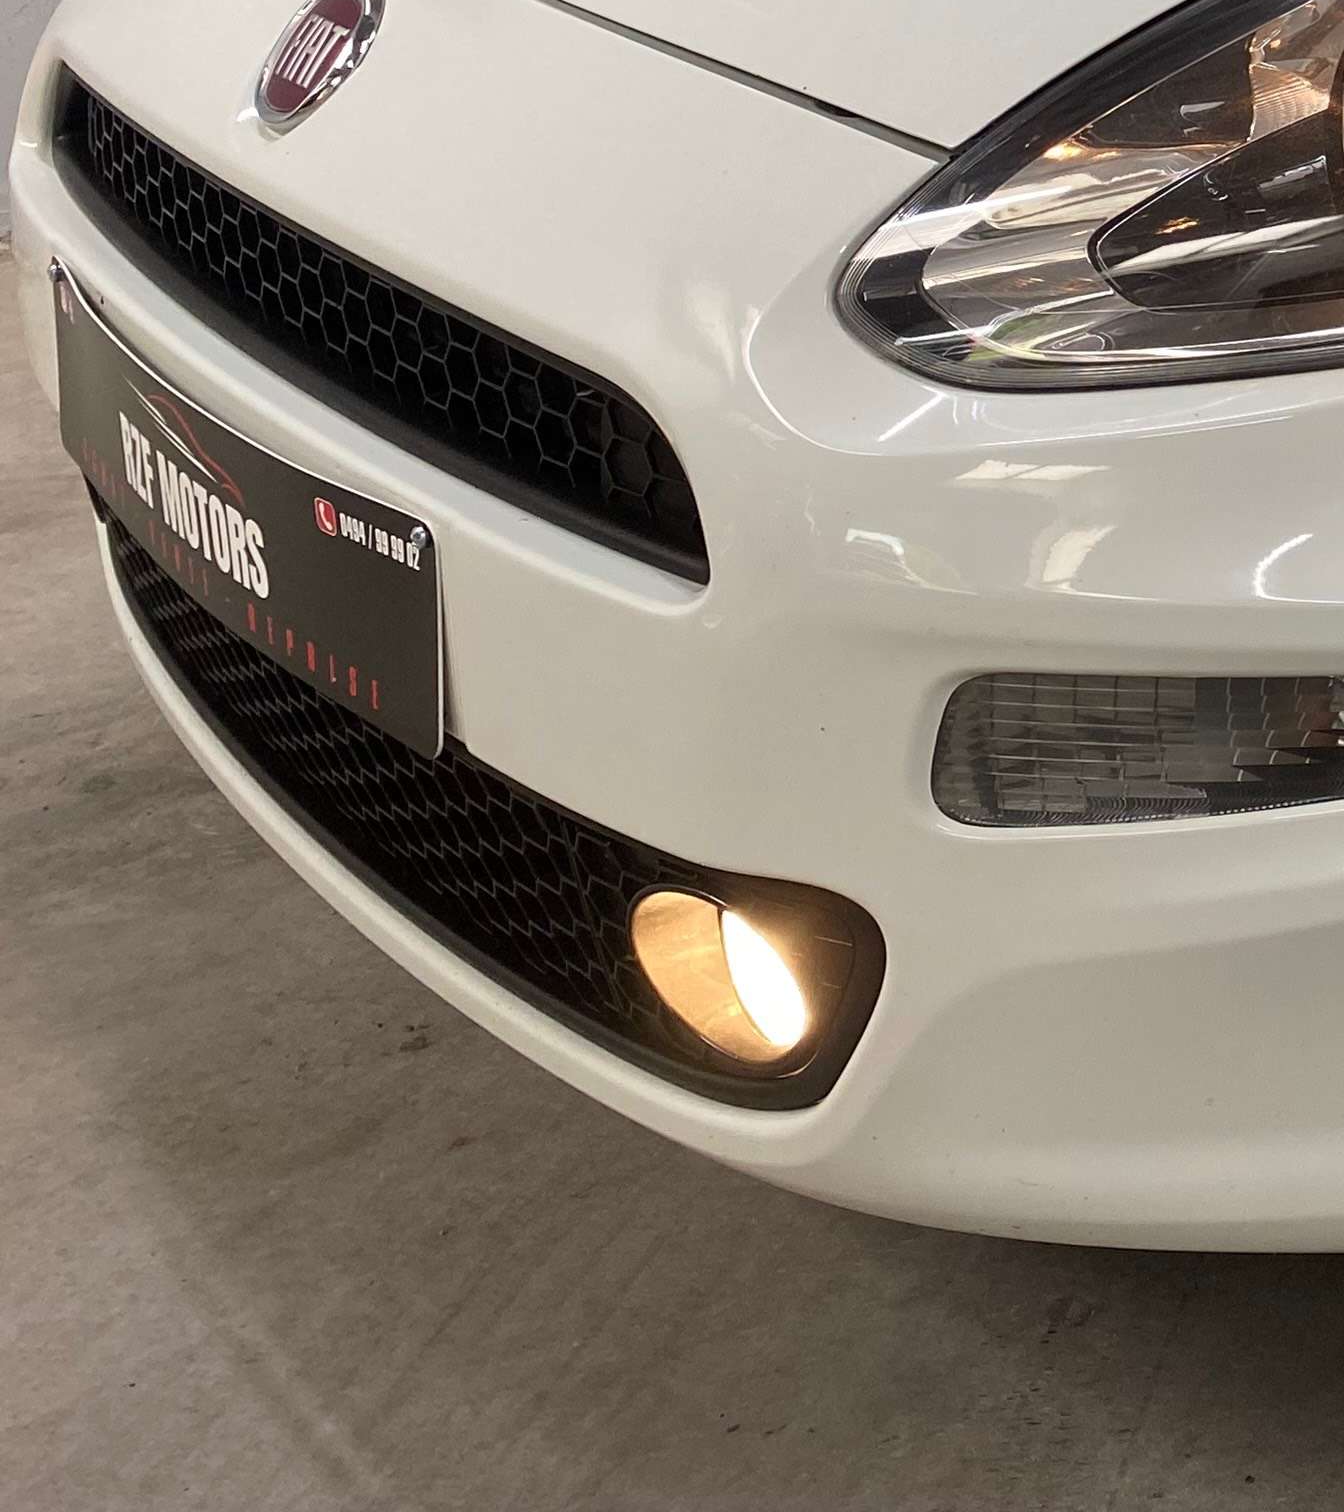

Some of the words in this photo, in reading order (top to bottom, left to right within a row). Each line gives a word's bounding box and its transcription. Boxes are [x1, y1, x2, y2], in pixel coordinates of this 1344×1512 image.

[275, 13, 350, 89] FIAT
[119, 411, 154, 509] RZF
[155, 449, 270, 599] MOTORS
